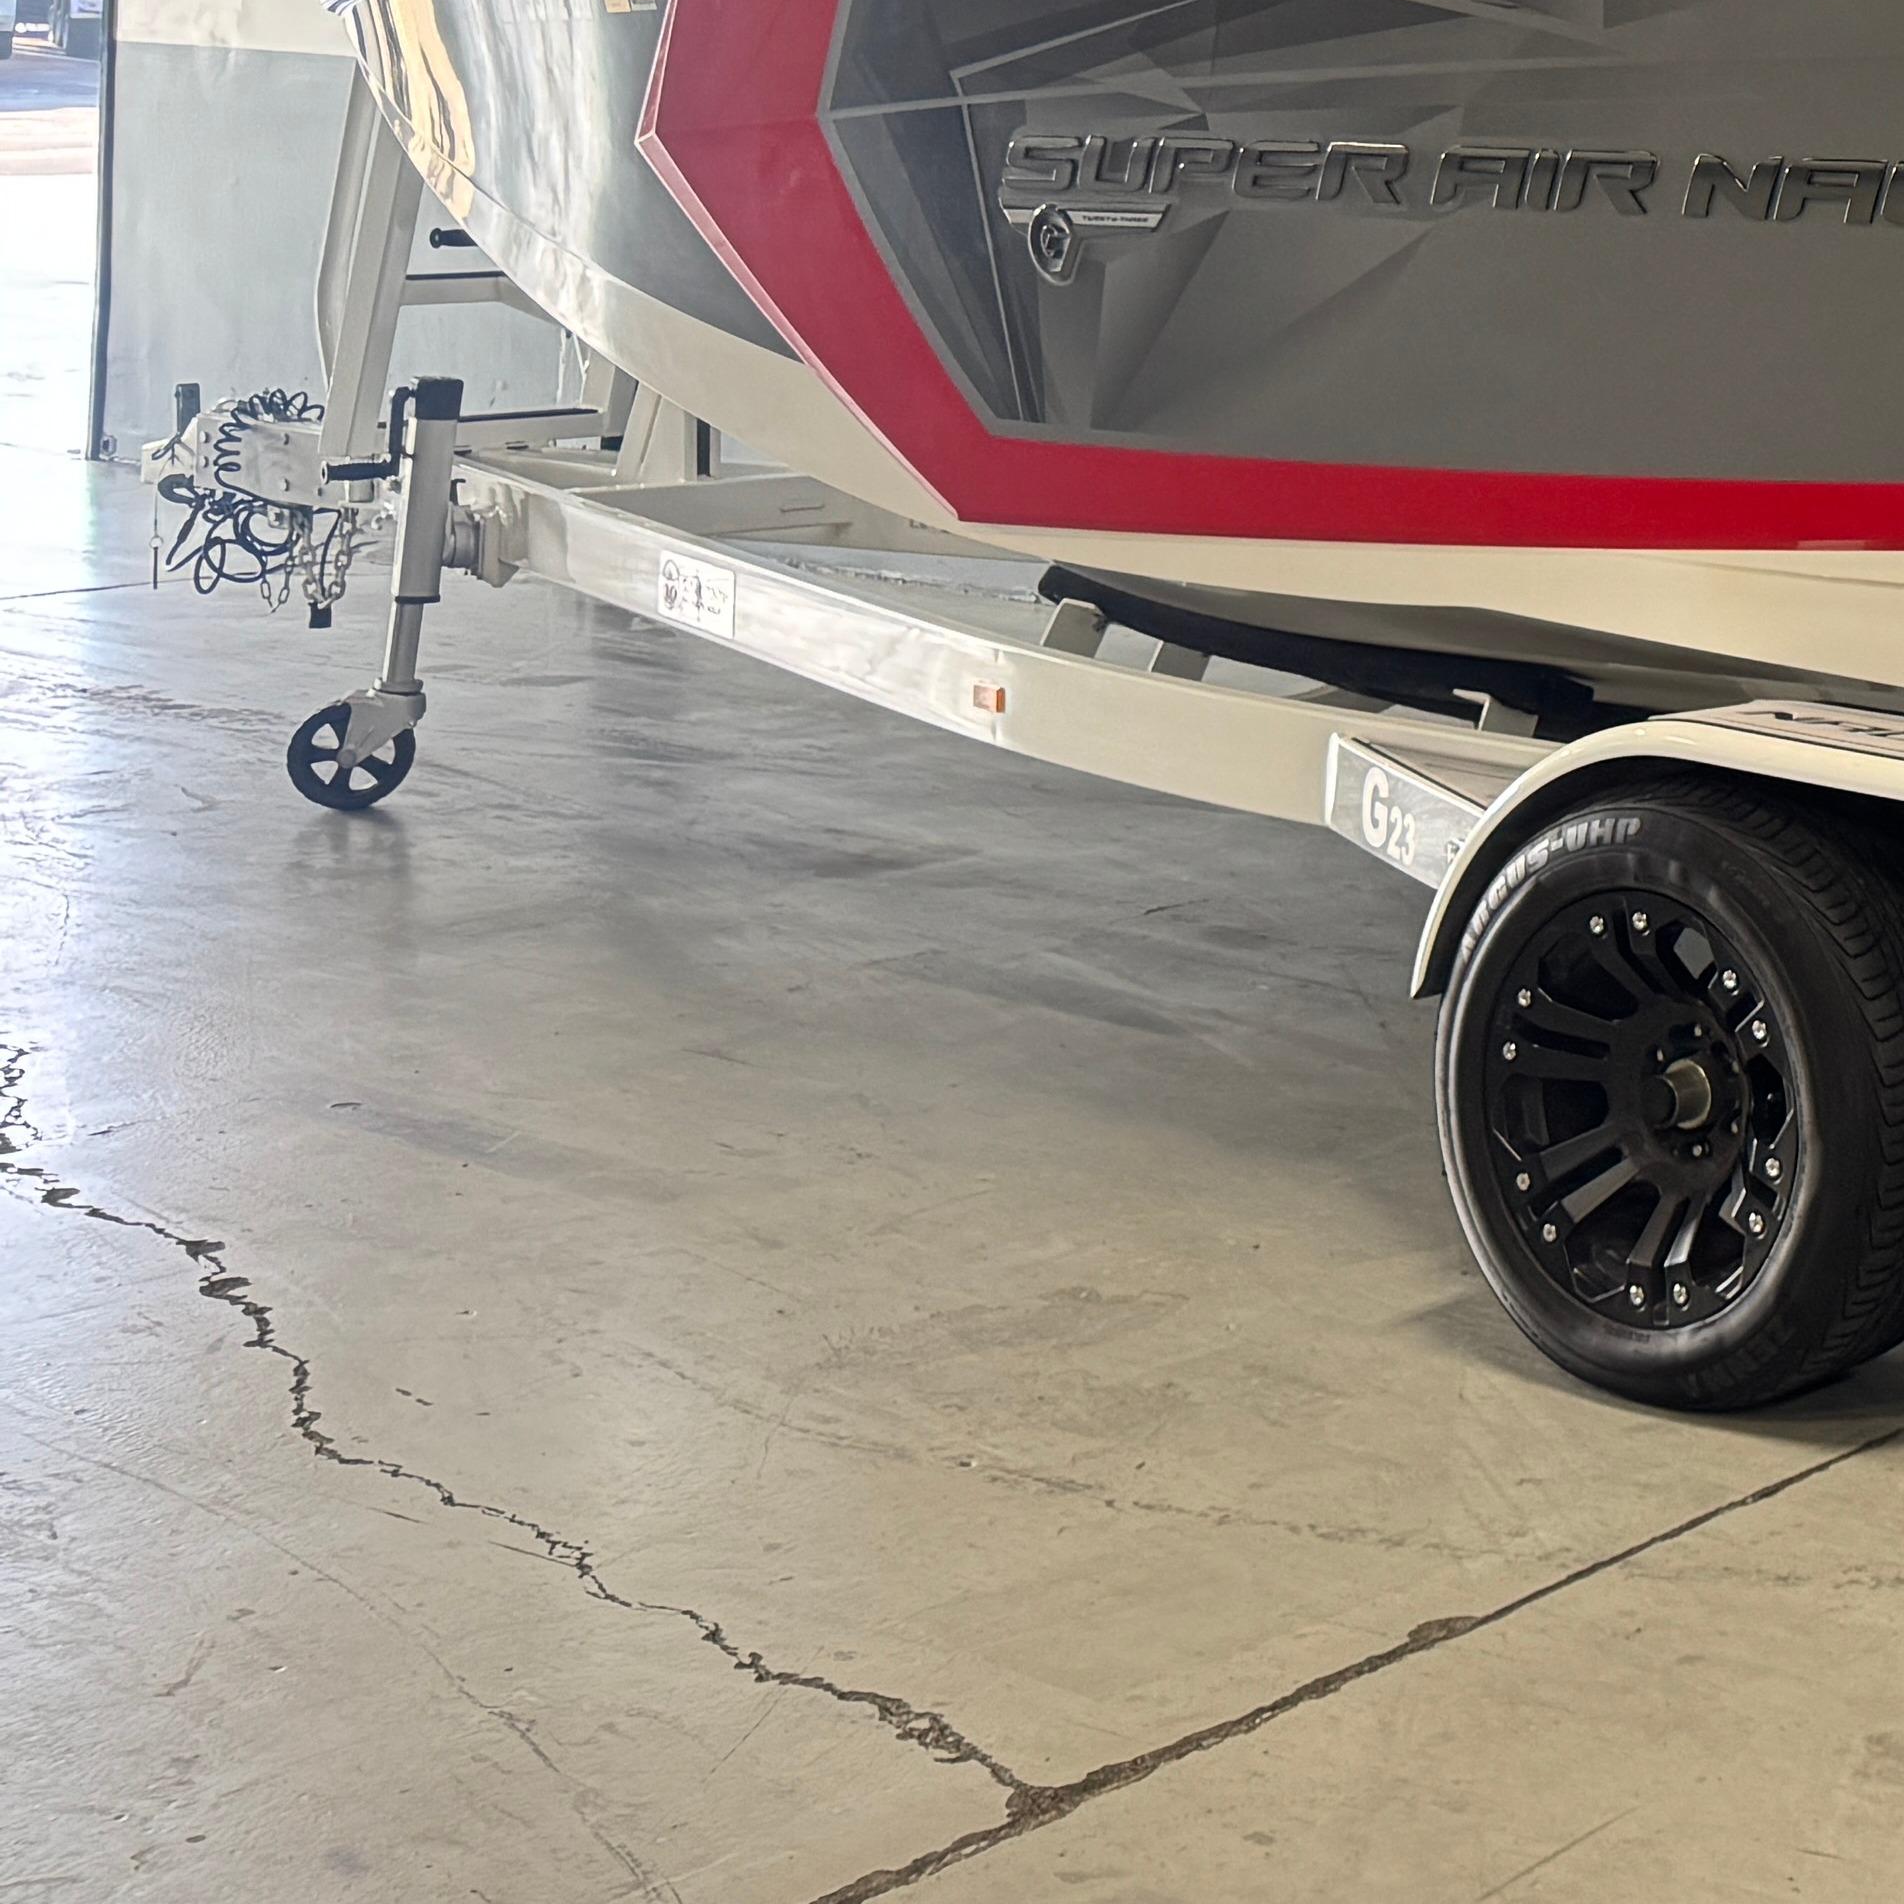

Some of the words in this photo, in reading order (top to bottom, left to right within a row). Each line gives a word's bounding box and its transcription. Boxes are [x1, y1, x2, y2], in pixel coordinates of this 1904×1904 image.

[1000, 134, 1405, 204] SUPER
[1431, 145, 1660, 213] AIR
[1362, 766, 1416, 866] G23
[1460, 817, 1642, 966] ARGUS-UHP
